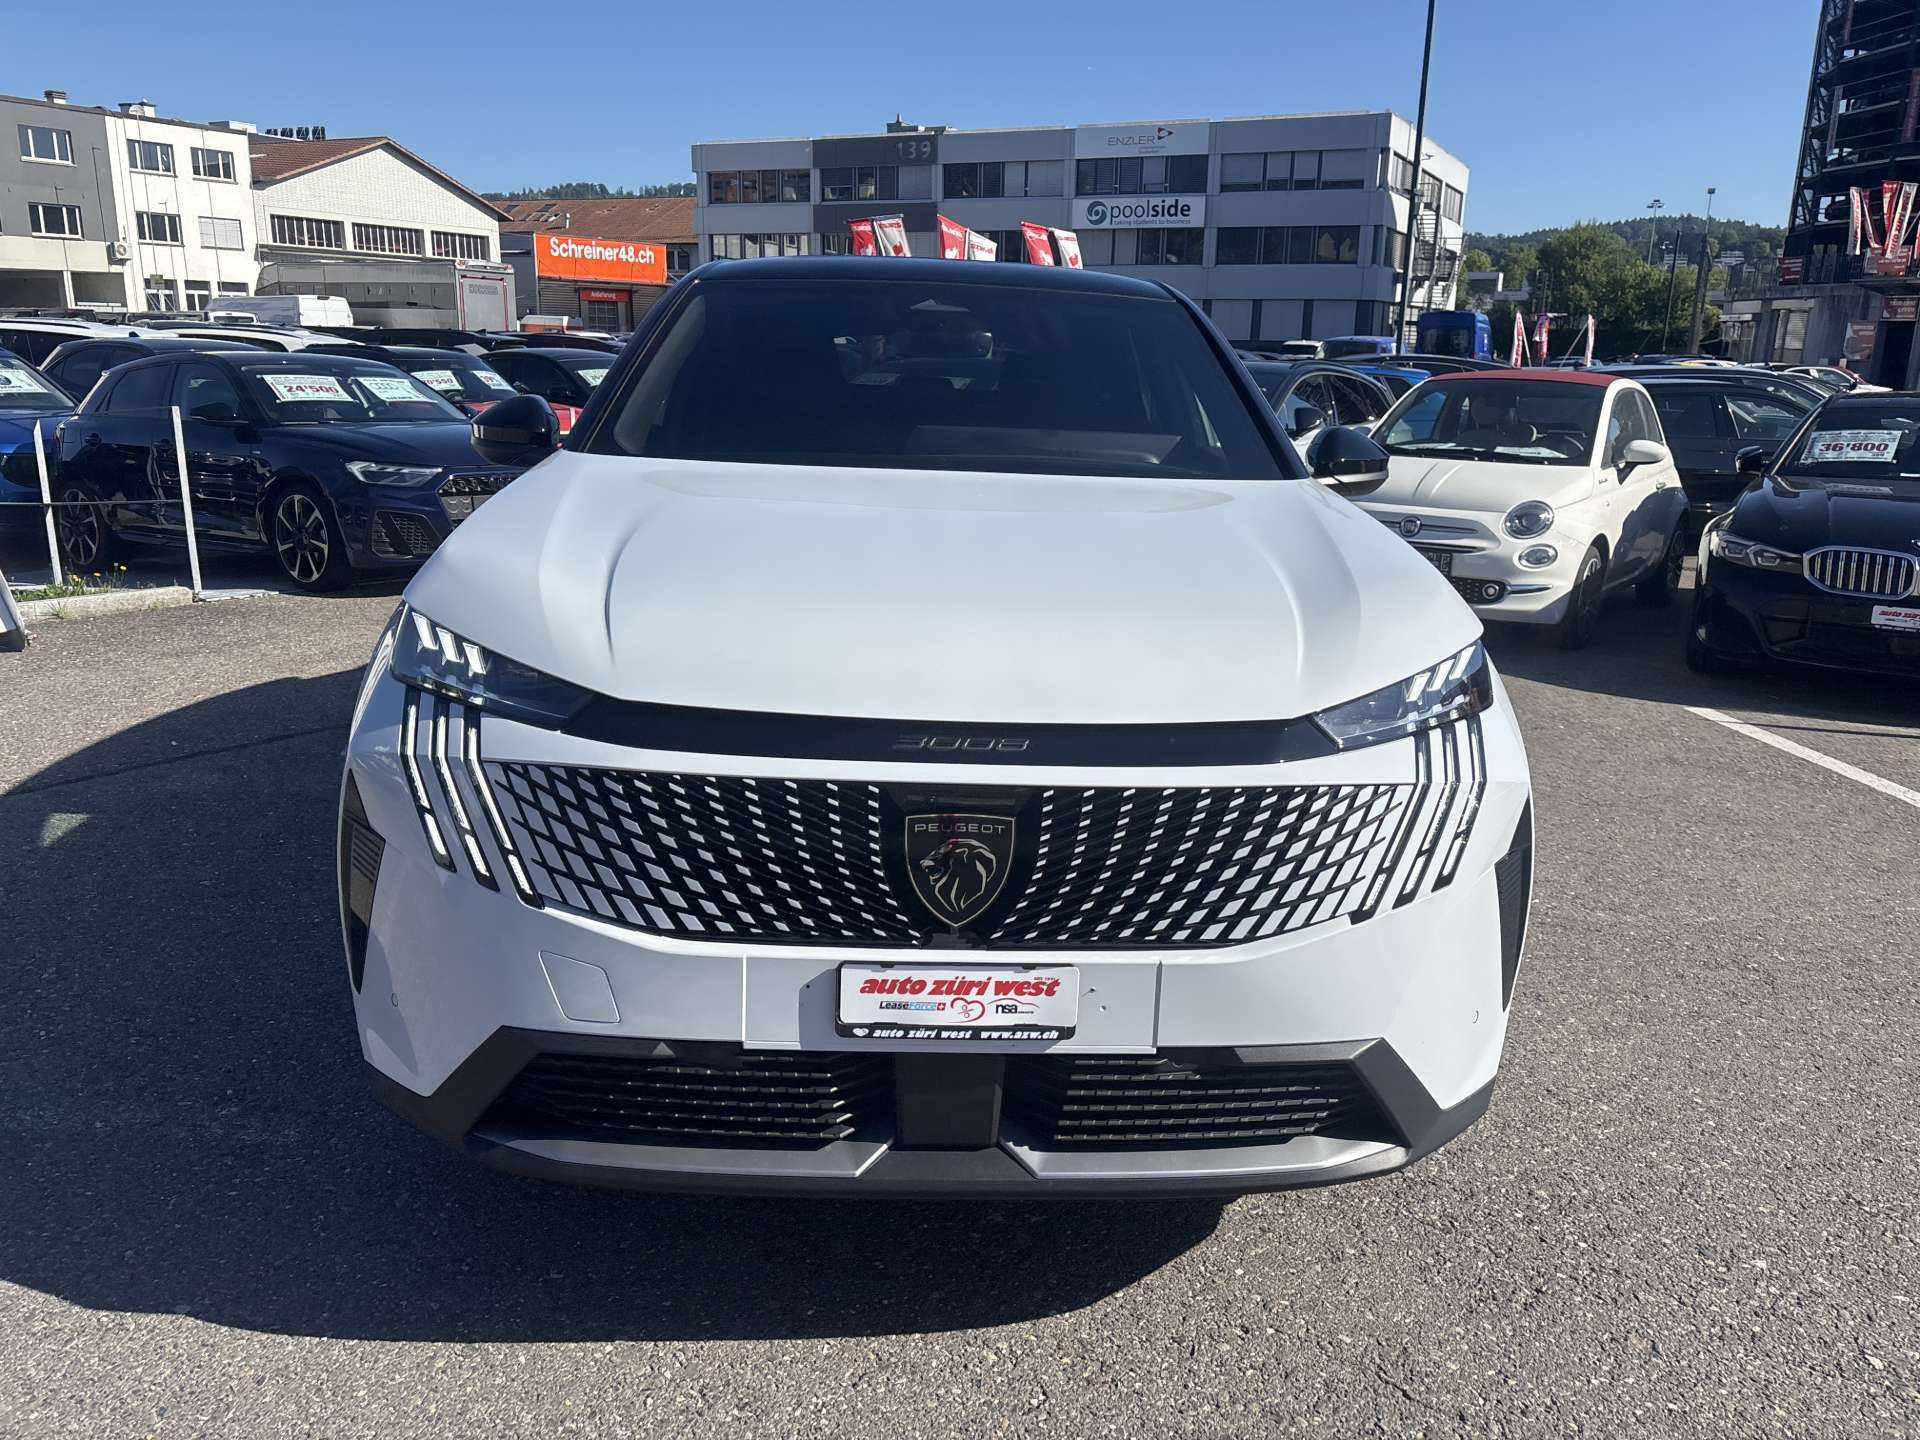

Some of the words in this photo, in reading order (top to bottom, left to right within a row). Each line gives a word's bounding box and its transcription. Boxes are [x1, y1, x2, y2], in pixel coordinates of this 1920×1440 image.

[1107, 135, 1155, 146] ENZLER
[897, 141, 931, 159] 139
[1110, 198, 1191, 225] poolside
[550, 236, 655, 264] Schreiner48.ch
[283, 385, 339, 394] 24'500
[1819, 442, 1889, 452] 36'800
[893, 736, 1030, 751] 3008
[914, 823, 1005, 834] PEUGEOT
[859, 976, 927, 995] auto
[928, 976, 992, 996] züri
[994, 978, 1060, 997] west
[995, 1004, 1018, 1014] nsa
[873, 1029, 903, 1038] auto
[906, 1028, 938, 1039] züri
[940, 1030, 972, 1039] west
[980, 1030, 1058, 1040] www.azw.ch
